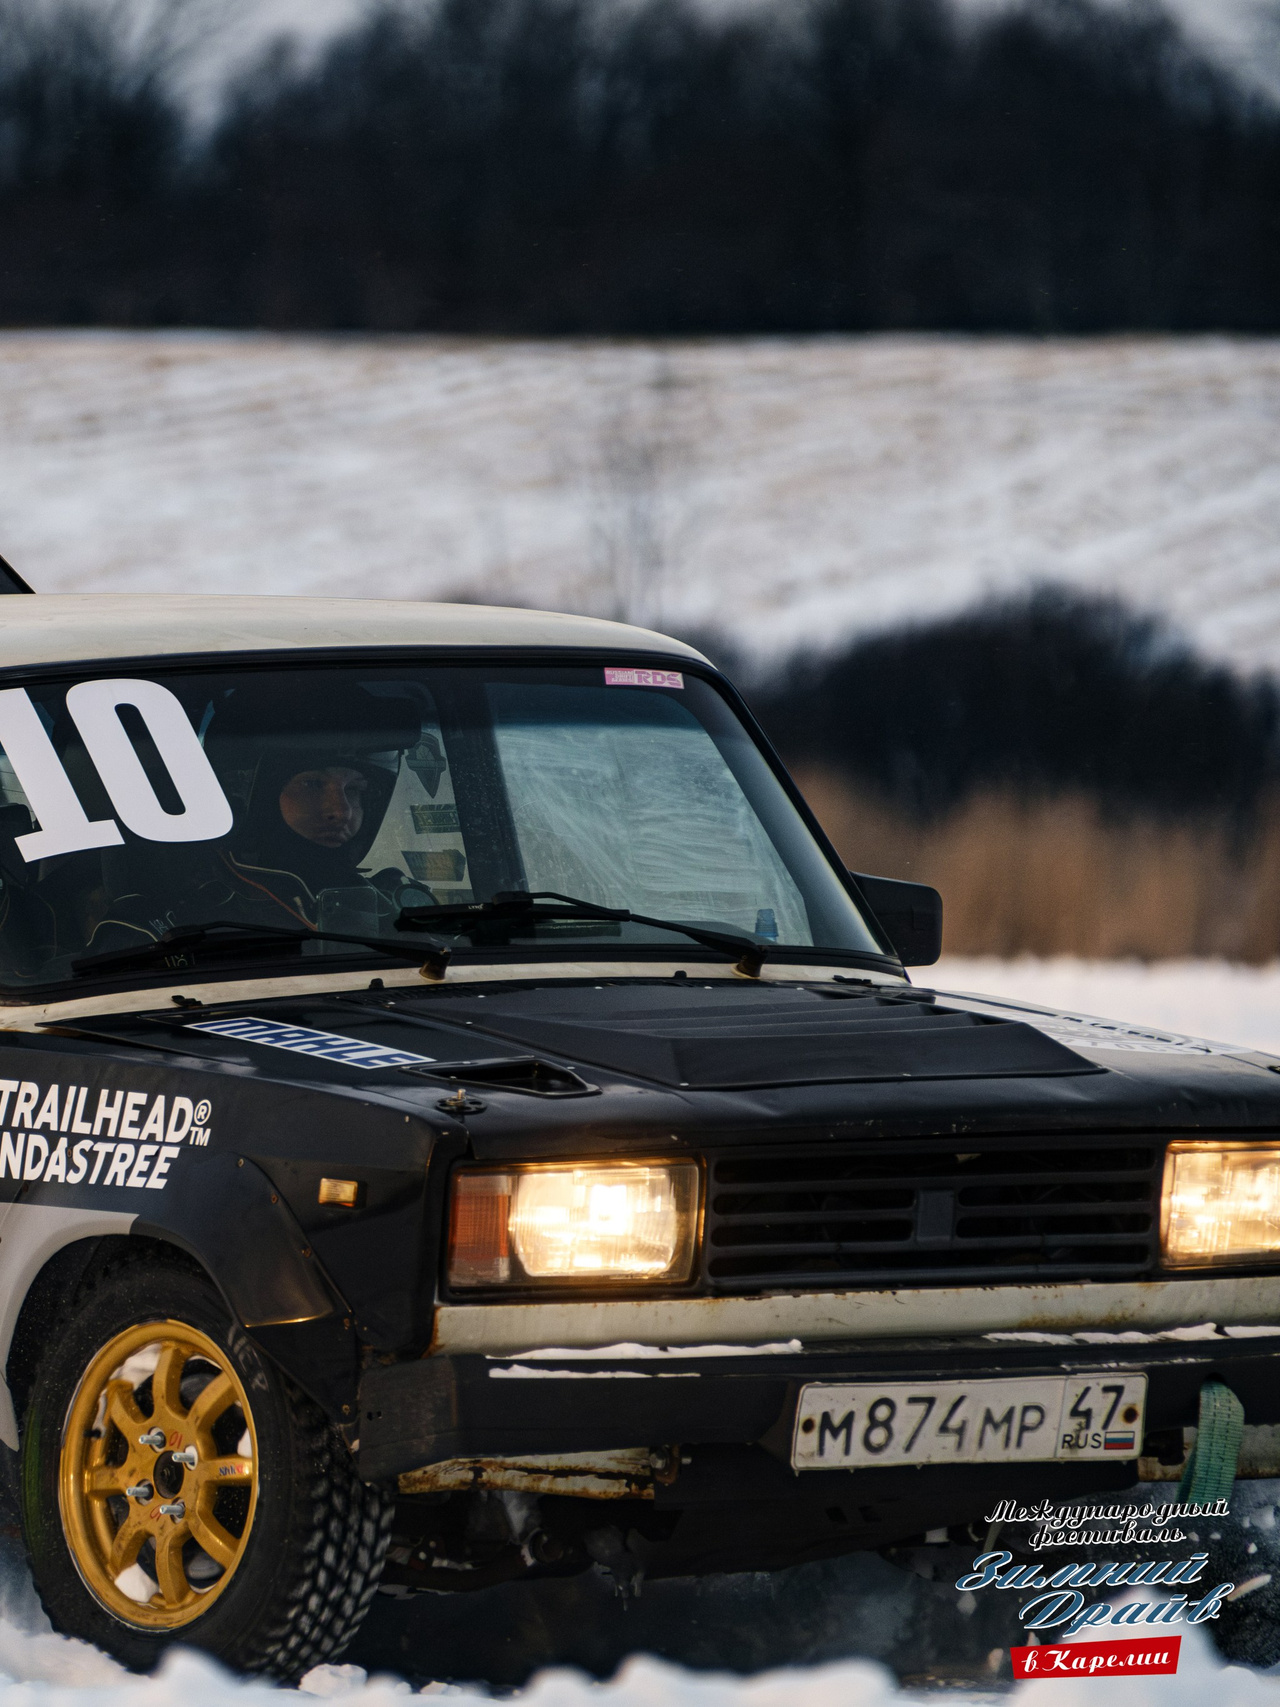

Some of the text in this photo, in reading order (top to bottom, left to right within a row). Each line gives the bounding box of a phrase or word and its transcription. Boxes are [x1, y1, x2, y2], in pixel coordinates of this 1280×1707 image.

[634, 670, 682, 687] RDS
[1068, 1385, 1125, 1431] 47
[1061, 1432, 1103, 1450] RUS
